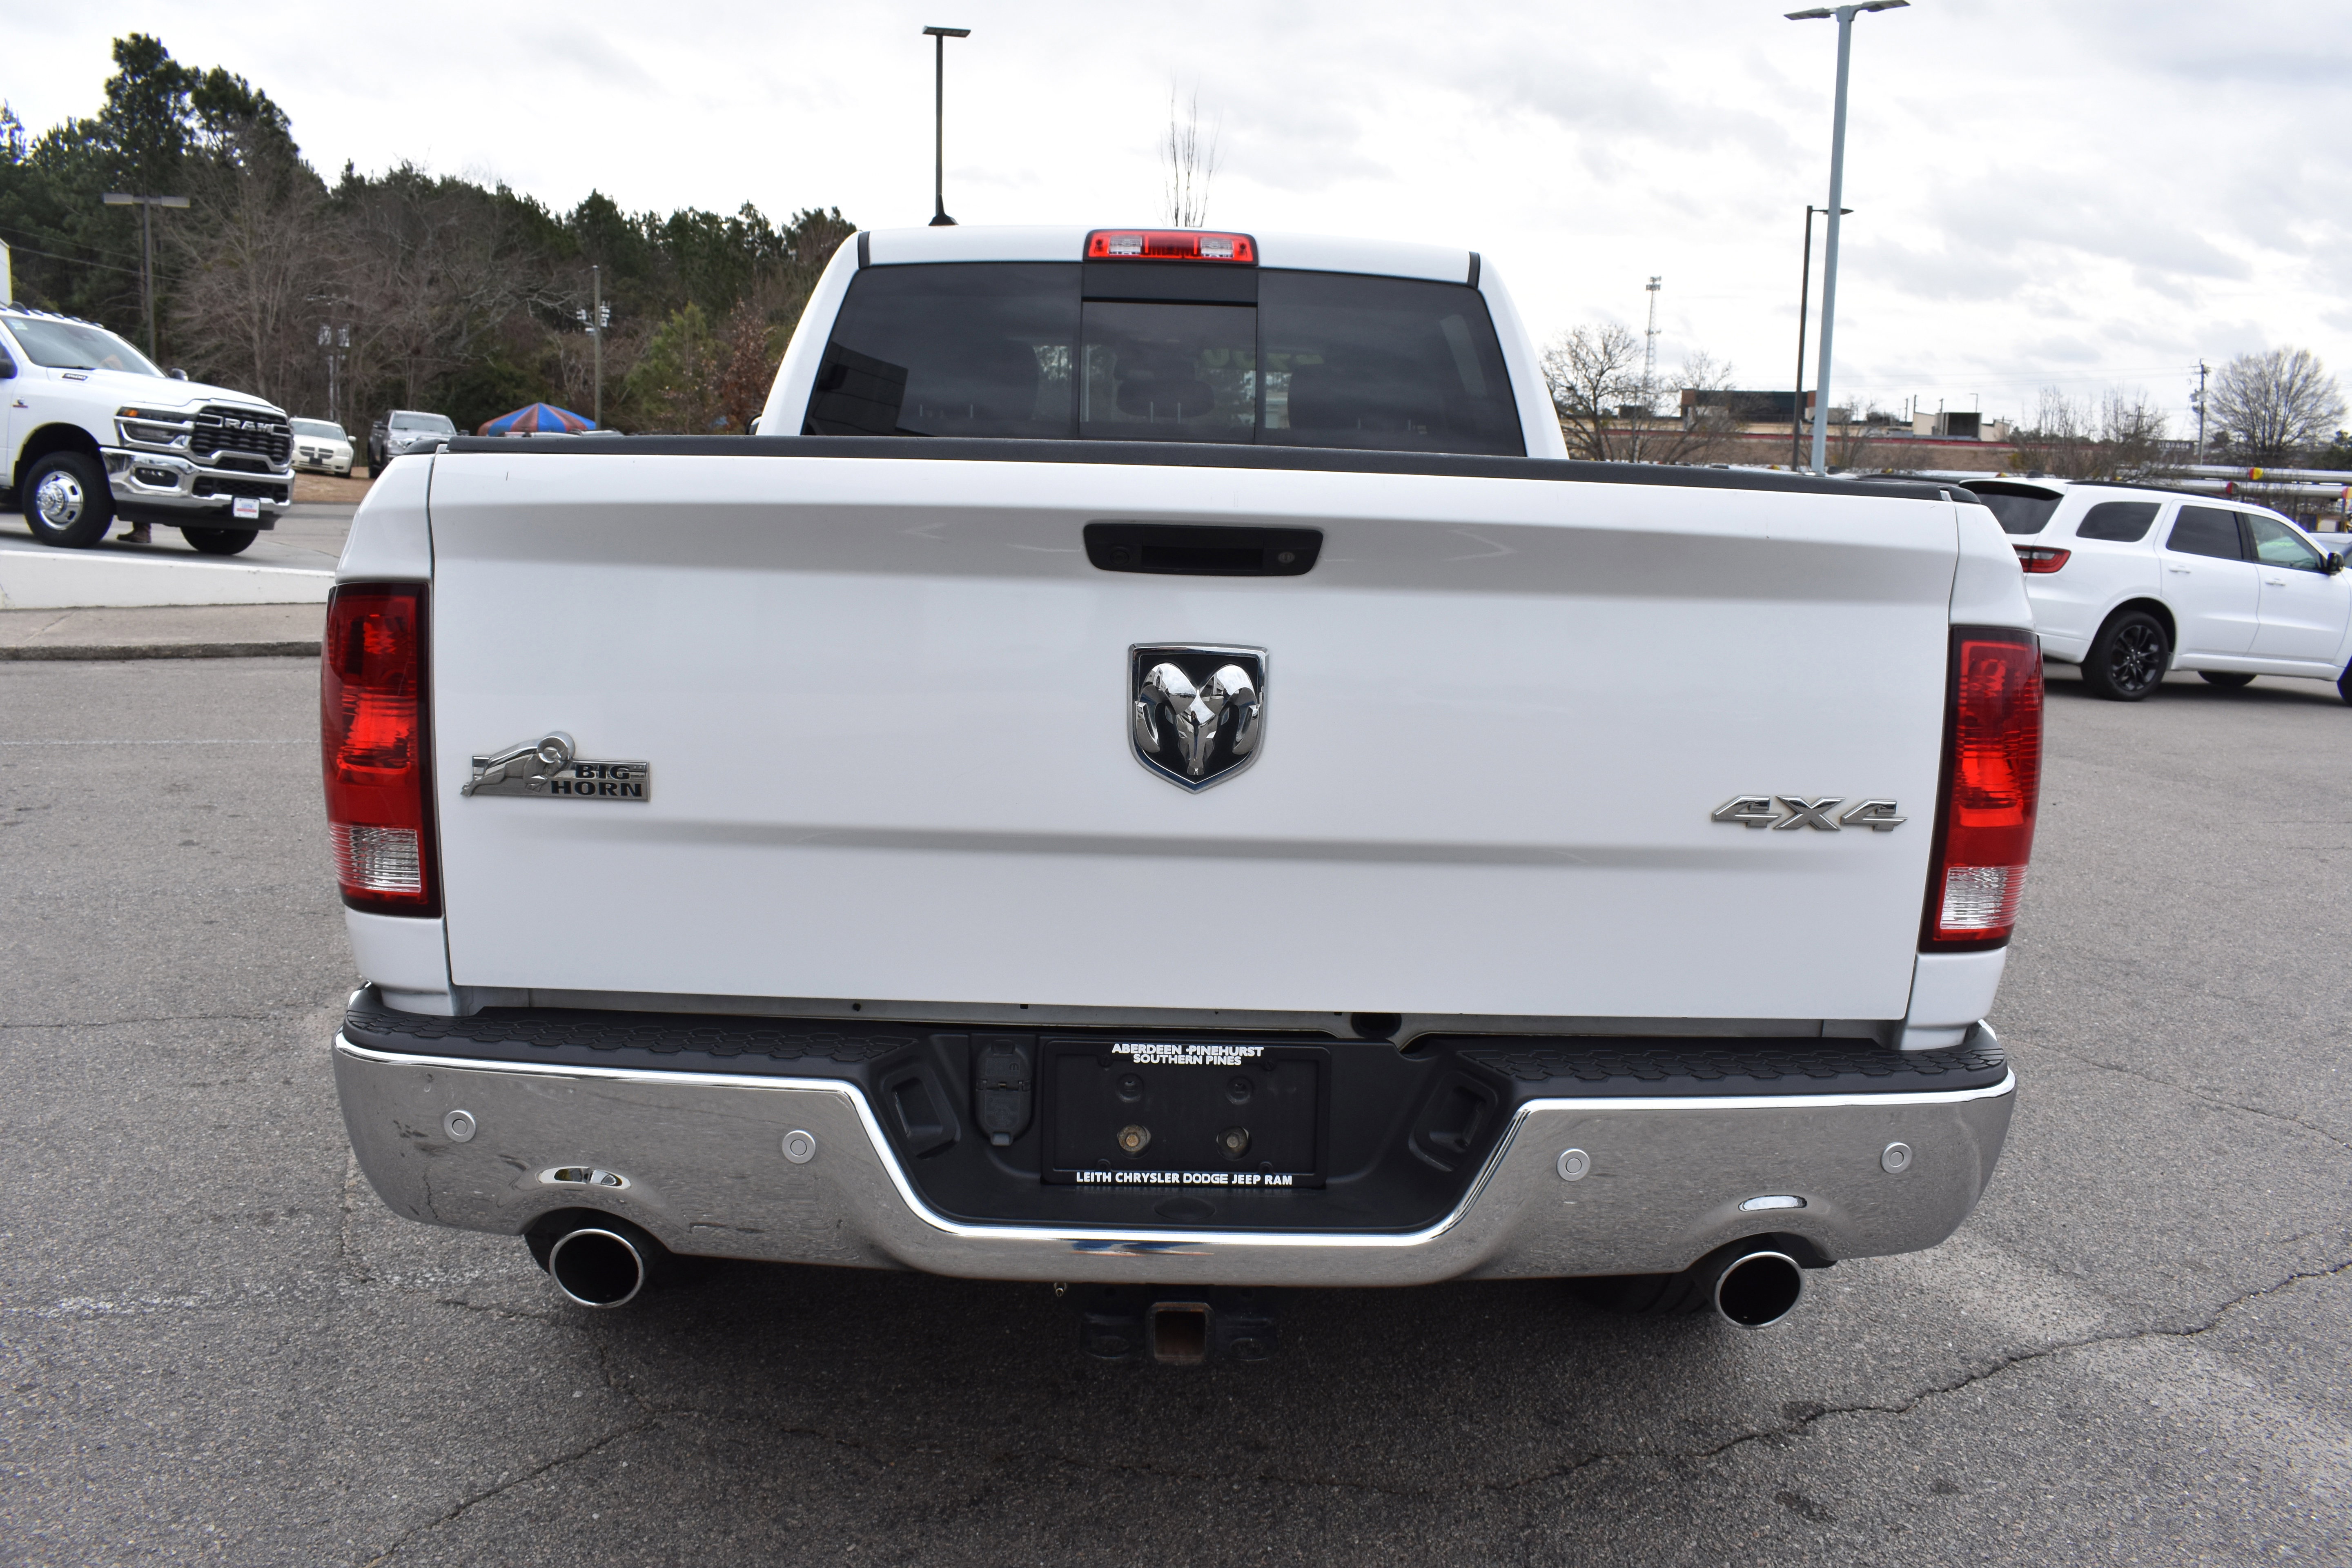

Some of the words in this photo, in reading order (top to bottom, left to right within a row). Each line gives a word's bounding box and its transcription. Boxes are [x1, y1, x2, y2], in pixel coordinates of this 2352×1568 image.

[225, 418, 273, 433] RAM
[575, 764, 630, 780] BIG
[551, 780, 642, 797] HORN
[1711, 795, 1908, 832] 4X4
[1111, 1043, 1182, 1055] ABERDEEN
[1133, 1054, 1203, 1065] SOUTHERN
[1206, 1055, 1241, 1065] PINES
[1076, 1172, 1111, 1183] LEITH
[1115, 1172, 1180, 1183] CHRYSLER
[1183, 1173, 1228, 1184] DODGE
[1232, 1174, 1261, 1185] JEEP
[1265, 1175, 1292, 1185] RAM
